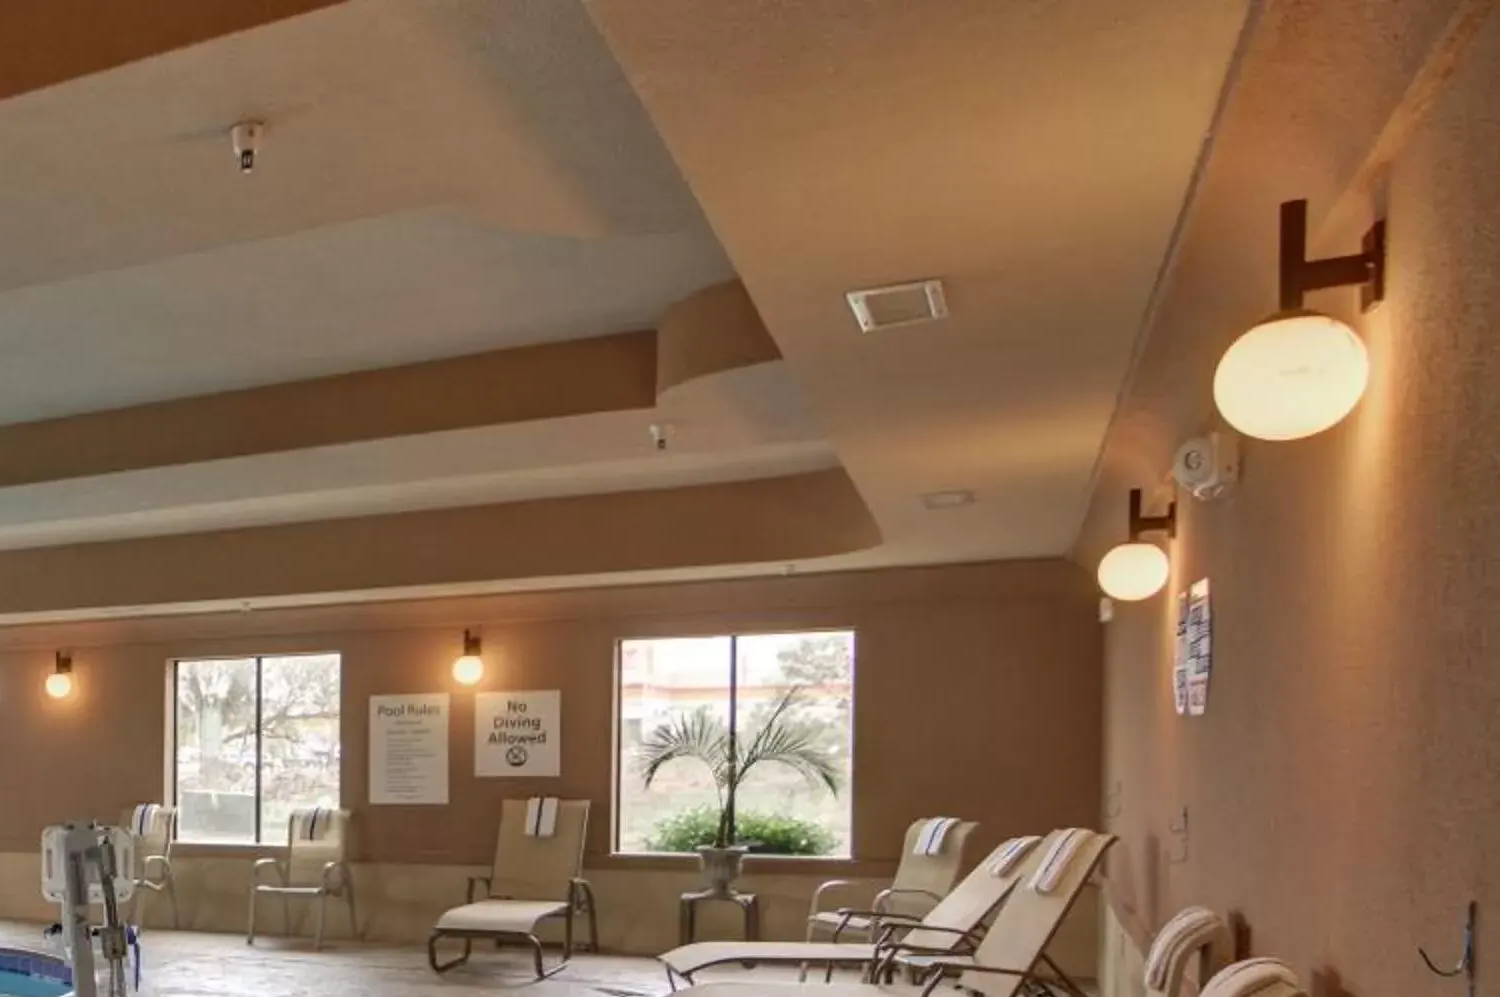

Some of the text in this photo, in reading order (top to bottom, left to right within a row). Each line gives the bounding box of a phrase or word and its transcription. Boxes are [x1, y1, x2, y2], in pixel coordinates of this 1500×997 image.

[378, 703, 441, 717] Pool Rules
[507, 700, 527, 713] No
[493, 717, 540, 731] Diving
[488, 731, 547, 745] Allowed
